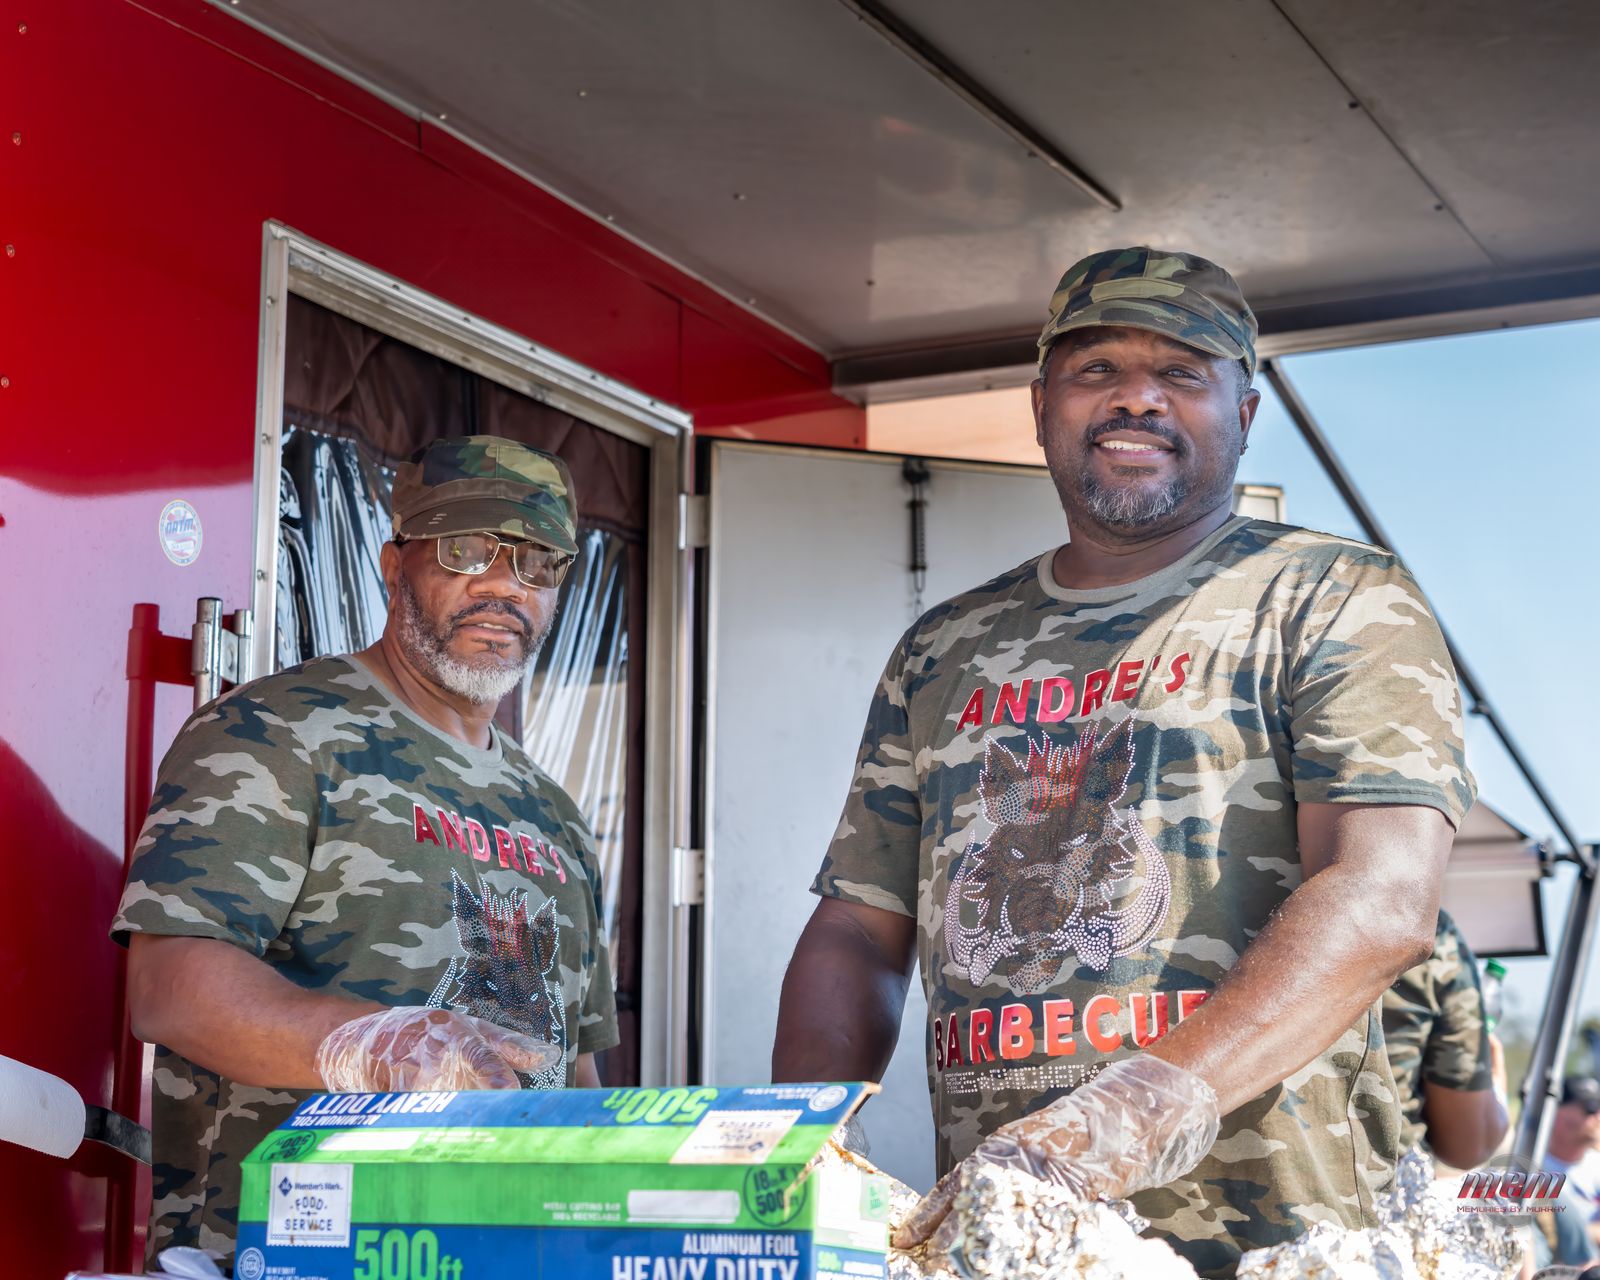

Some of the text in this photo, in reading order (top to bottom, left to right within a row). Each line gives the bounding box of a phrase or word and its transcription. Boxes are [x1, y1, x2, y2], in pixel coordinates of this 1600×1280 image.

[955, 652, 1191, 732] ANDRE'S
[412, 802, 567, 885] ANDRE'S
[300, 1091, 459, 1115] HEAVY DUTY
[602, 1087, 719, 1123] 500ft
[291, 1114, 382, 1127] ALUMINUM FOIL
[295, 1196, 324, 1211] FOOD
[284, 1218, 332, 1232] SERVICE
[353, 1229, 464, 1280] 500ft
[682, 1233, 800, 1257] ALUMINUM FOIL
[612, 1255, 709, 1280] HEAVY
[715, 1257, 800, 1280] DUTY
